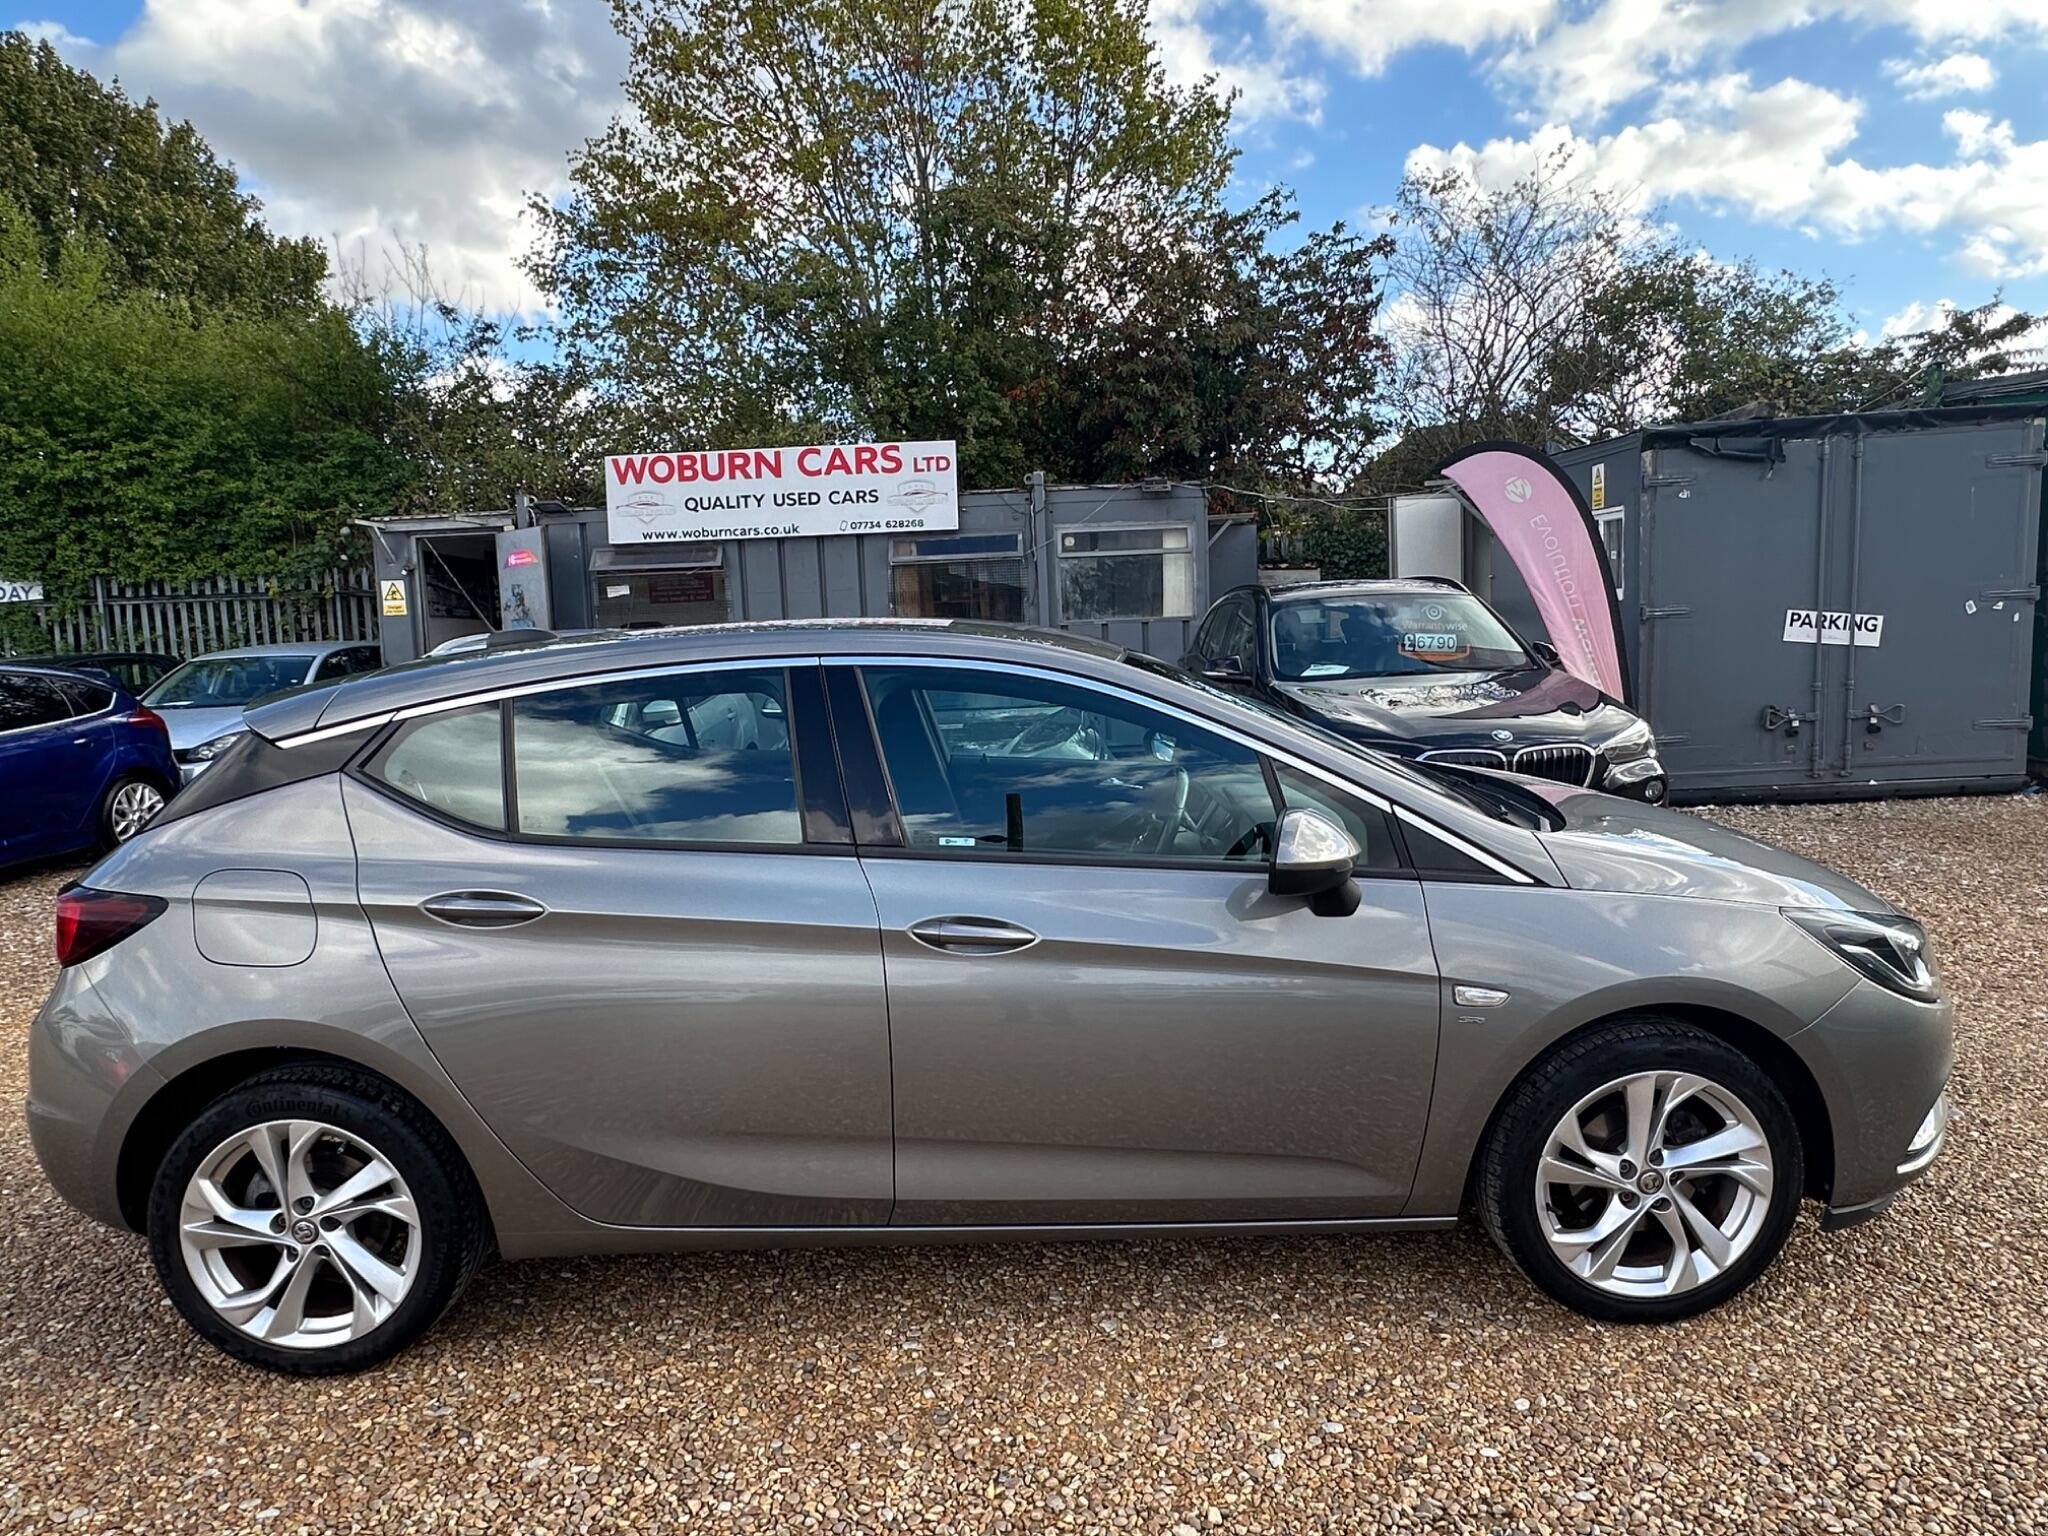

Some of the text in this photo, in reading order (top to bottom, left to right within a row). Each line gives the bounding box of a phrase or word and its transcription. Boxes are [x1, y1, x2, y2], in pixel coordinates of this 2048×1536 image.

[611, 445, 951, 485] WOBURN CARS LTD
[684, 493, 765, 512] QUALITY
[773, 491, 821, 507] USED
[828, 489, 879, 505] CARS
[642, 519, 925, 540] www.woburncars.co.uk 07734 628268
[1789, 612, 1878, 632] PARKING
[1404, 634, 1456, 650] £6790
[246, 1097, 341, 1117] Continental
